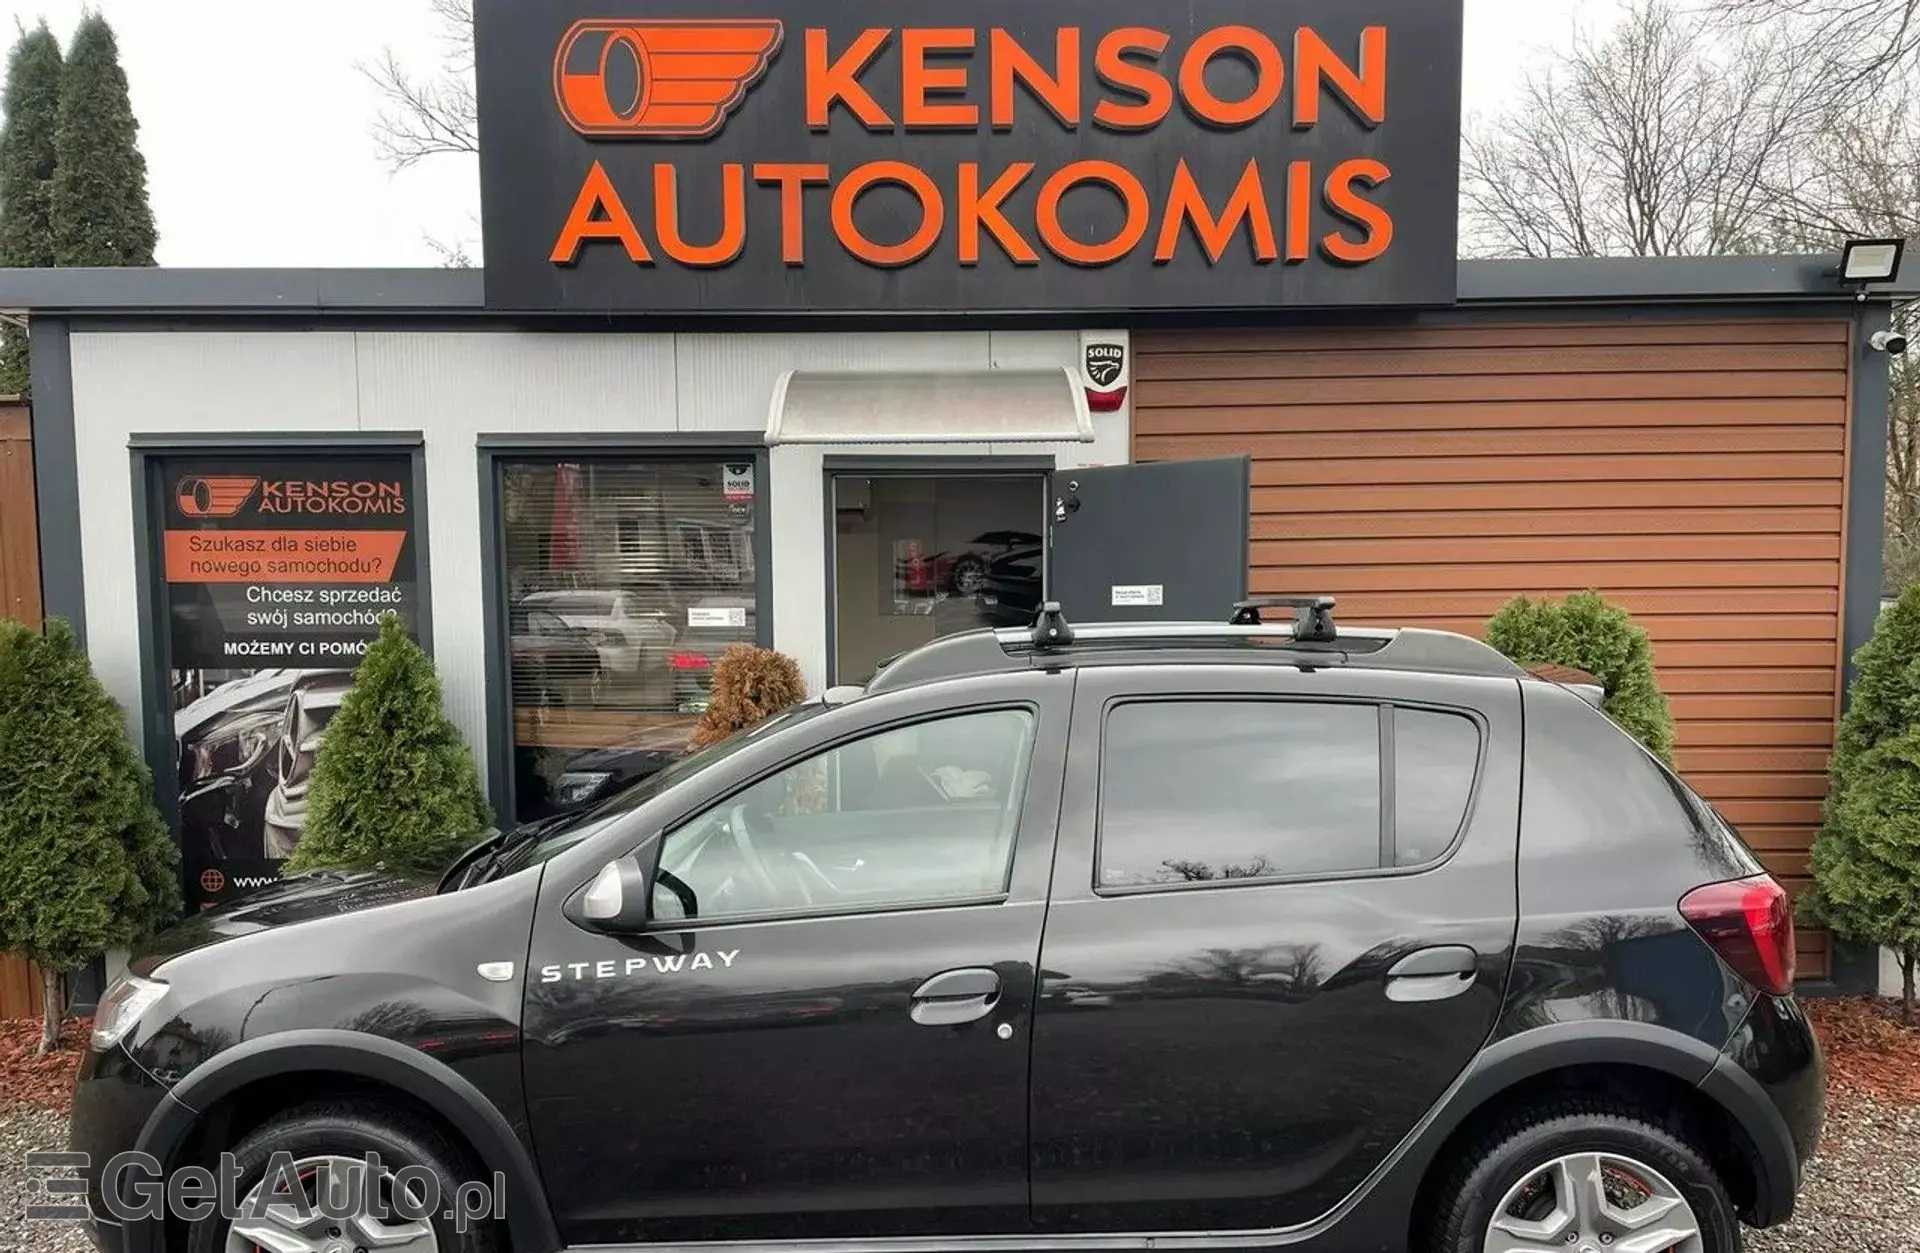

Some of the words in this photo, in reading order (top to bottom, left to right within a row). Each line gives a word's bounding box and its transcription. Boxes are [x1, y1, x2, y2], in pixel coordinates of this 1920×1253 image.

[804, 26, 1386, 130] KENSON
[549, 158, 1393, 267] AUTOKOMIS
[1088, 347, 1122, 358] SOLID
[262, 481, 400, 497] KENSON
[258, 497, 406, 513] AUTOKOMIS
[189, 535, 266, 552] Szukasz
[271, 535, 299, 552] dla
[304, 535, 357, 552] siebie
[190, 561, 262, 577] nowego
[267, 556, 383, 575] samochodu?
[246, 586, 314, 603] Chcesz
[319, 587, 402, 606] sprzedać
[247, 609, 289, 629] swój
[223, 639, 295, 655] MOŻEMY
[299, 641, 315, 655] CI
[319, 639, 368, 655] POMÓ
[541, 949, 741, 983] STEPWAY
